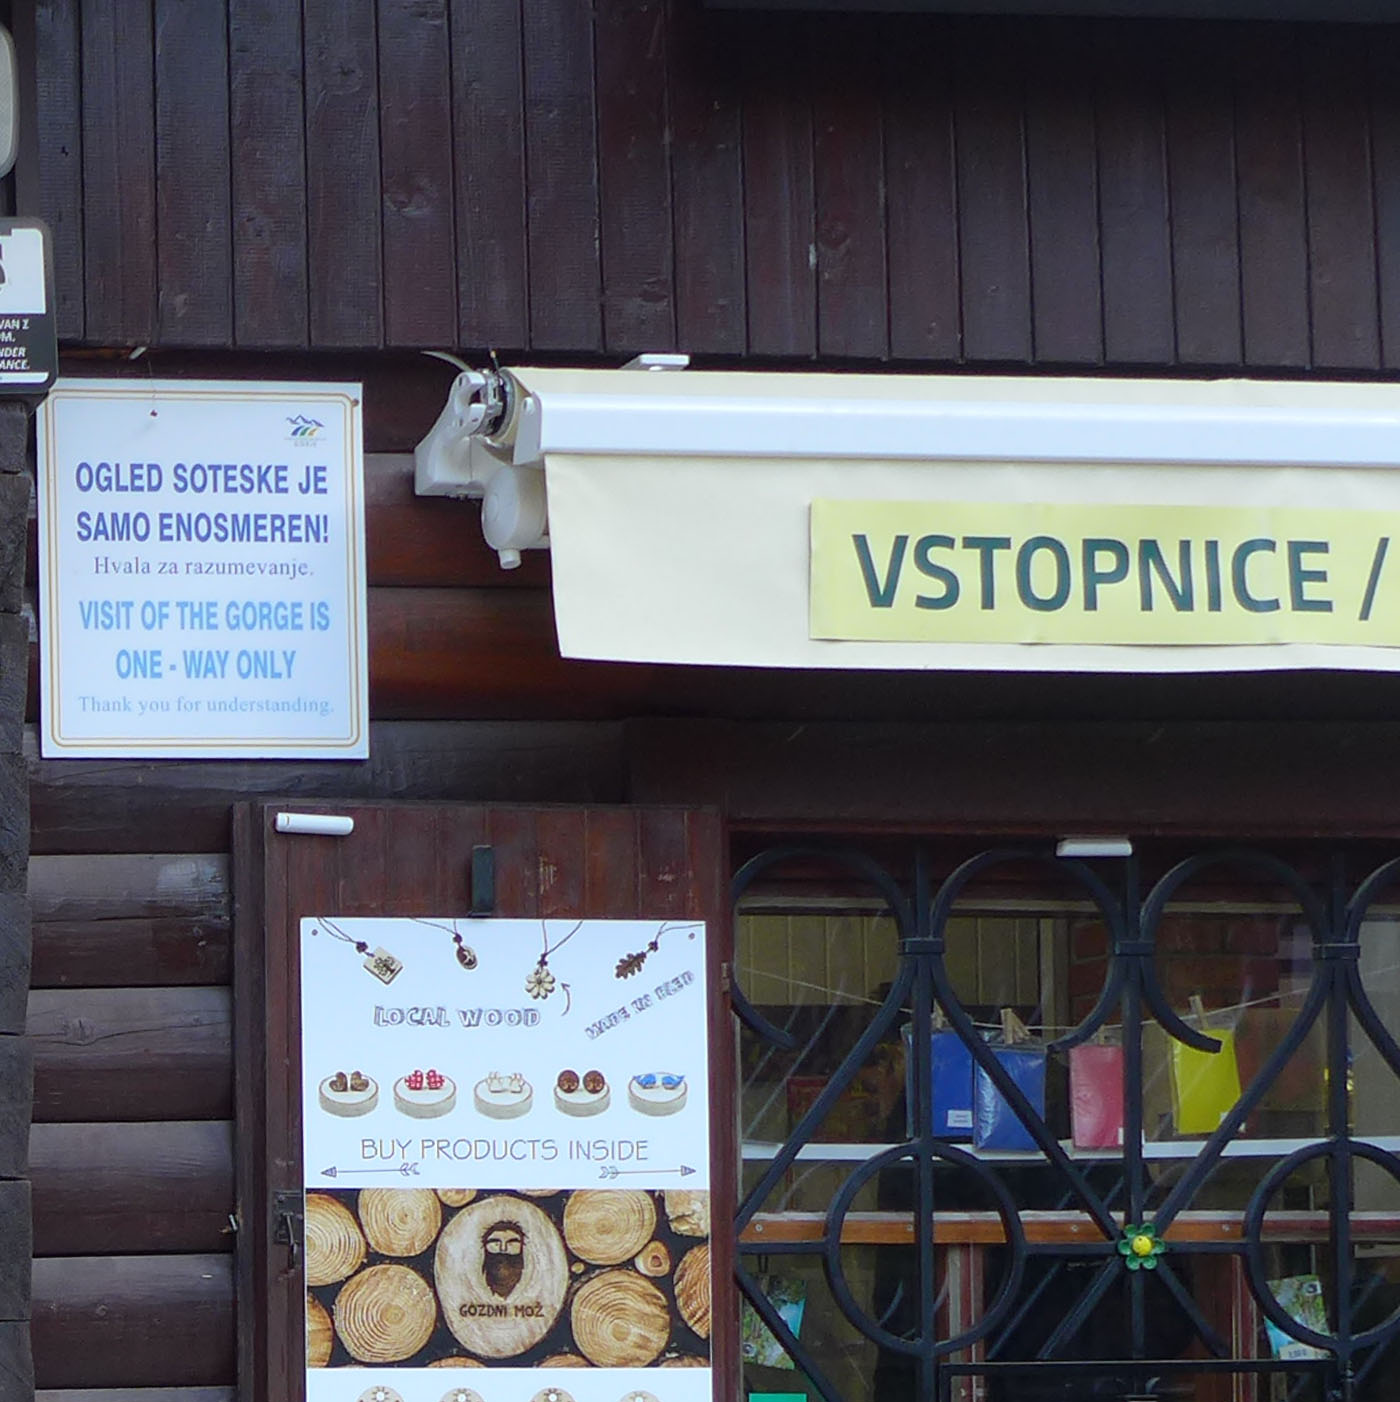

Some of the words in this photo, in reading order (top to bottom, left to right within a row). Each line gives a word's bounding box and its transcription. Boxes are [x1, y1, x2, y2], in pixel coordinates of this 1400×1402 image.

[22, 318, 30, 330] Z
[75, 462, 163, 495] OGLED
[172, 463, 290, 495] SOTESKE
[297, 465, 329, 495] JE
[76, 512, 151, 543] SAMO
[159, 512, 329, 544] ENOSMEREN!
[93, 556, 151, 576] Hvala
[157, 562, 180, 576] za
[184, 559, 315, 580] razumevanje.
[851, 533, 1334, 613] VSTOPNICE
[1357, 537, 1390, 621] /
[79, 600, 136, 631] VISIT
[140, 600, 171, 631] OF
[175, 600, 219, 631] THE
[225, 600, 304, 632] GORGE
[310, 601, 331, 632] IS
[115, 650, 163, 680] ONE
[182, 649, 230, 680] WAY
[236, 649, 296, 680] ONLY
[78, 695, 133, 714] Thank
[137, 699, 171, 718] you
[176, 695, 202, 713] for
[206, 695, 335, 717] understanding.
[373, 1005, 450, 1028] LOCAL
[457, 1007, 541, 1028] WOOD
[361, 1138, 412, 1160] BUY
[420, 1138, 559, 1161] PRODUCTS
[568, 1139, 649, 1161] INSIDE
[459, 1303, 508, 1318] GOZDNI
[513, 1301, 545, 1317] MOŽ
